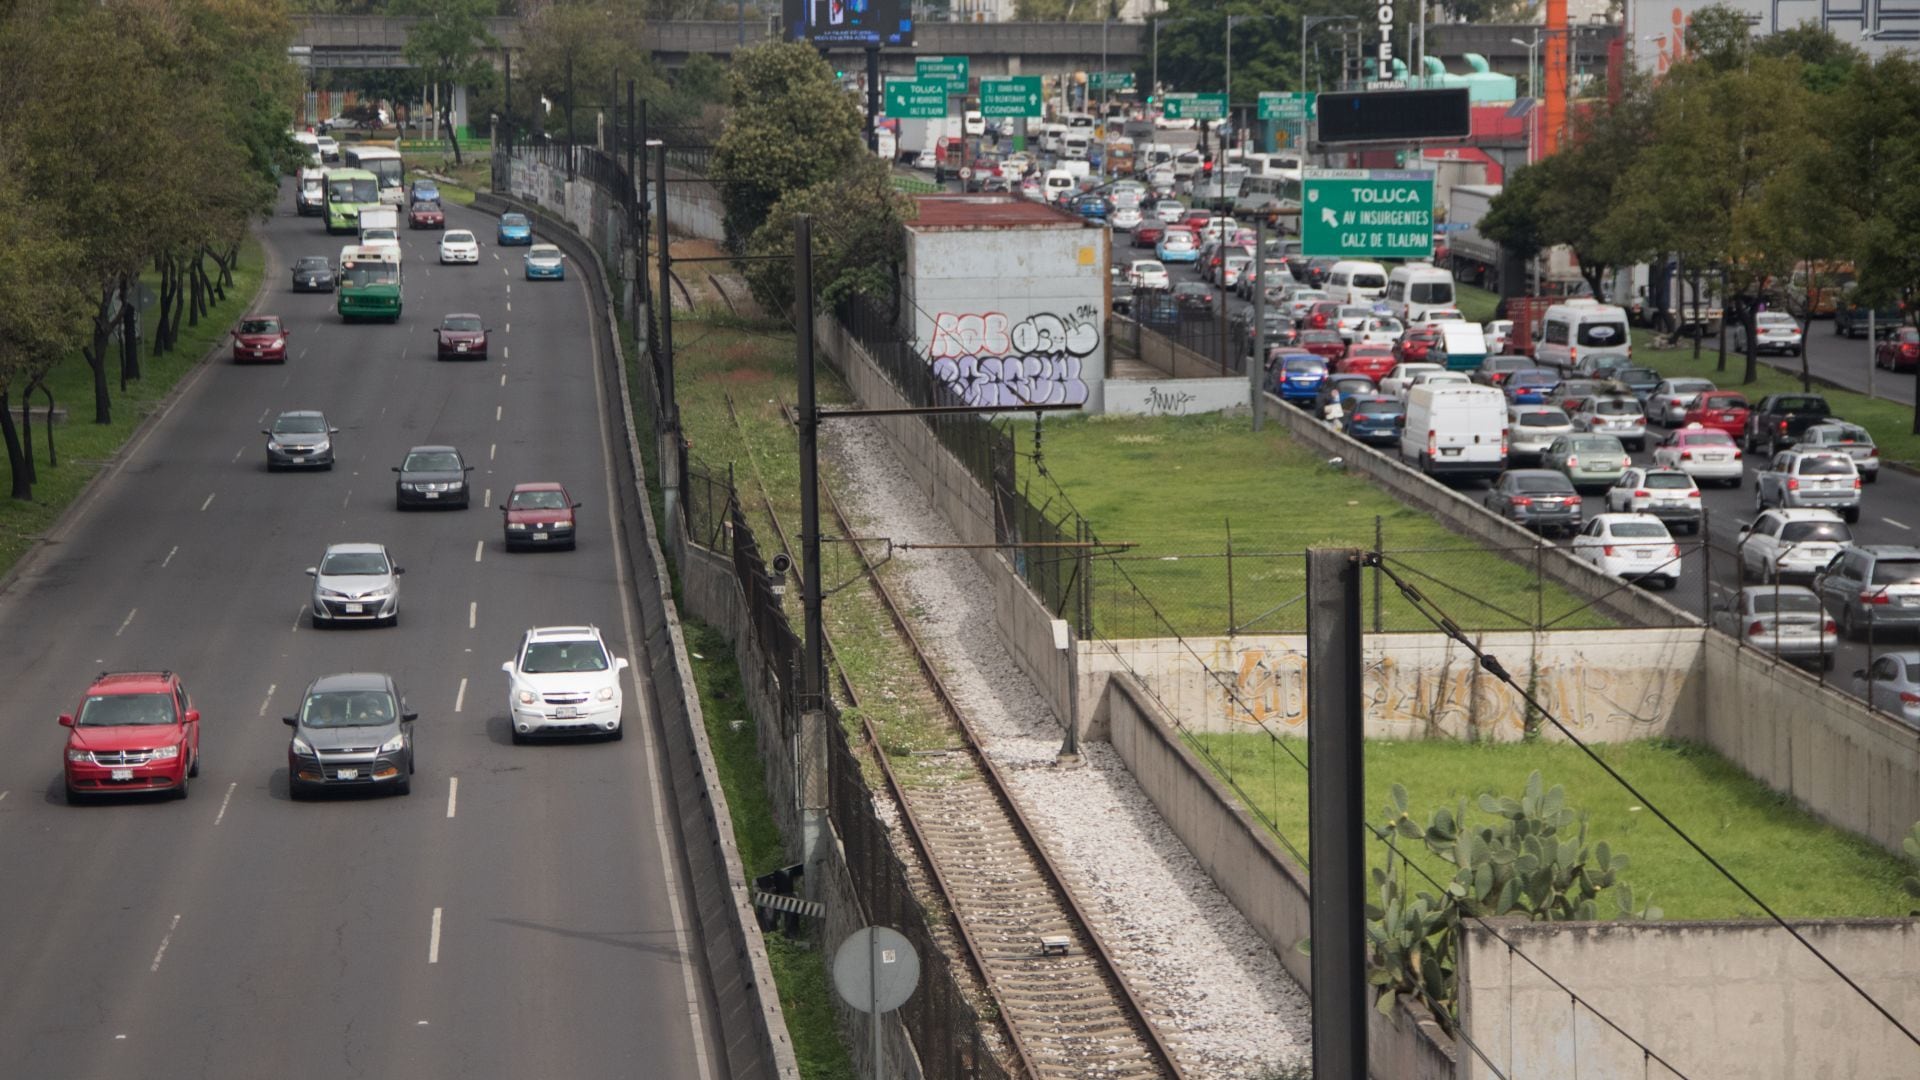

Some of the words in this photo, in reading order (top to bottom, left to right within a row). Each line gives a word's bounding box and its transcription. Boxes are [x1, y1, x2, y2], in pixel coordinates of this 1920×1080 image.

[1377, 0, 1393, 79] OTEL
[910, 85, 943, 94] TOLUCA
[984, 106, 1025, 114] ECONOMIA
[1352, 187, 1420, 203] TOLUCA
[1343, 210, 1356, 225] AV
[1360, 210, 1429, 226] INSURGENTES
[1341, 232, 1366, 248] CALZ
[1370, 232, 1383, 248] DE
[1387, 232, 1429, 248] TLALPAN
